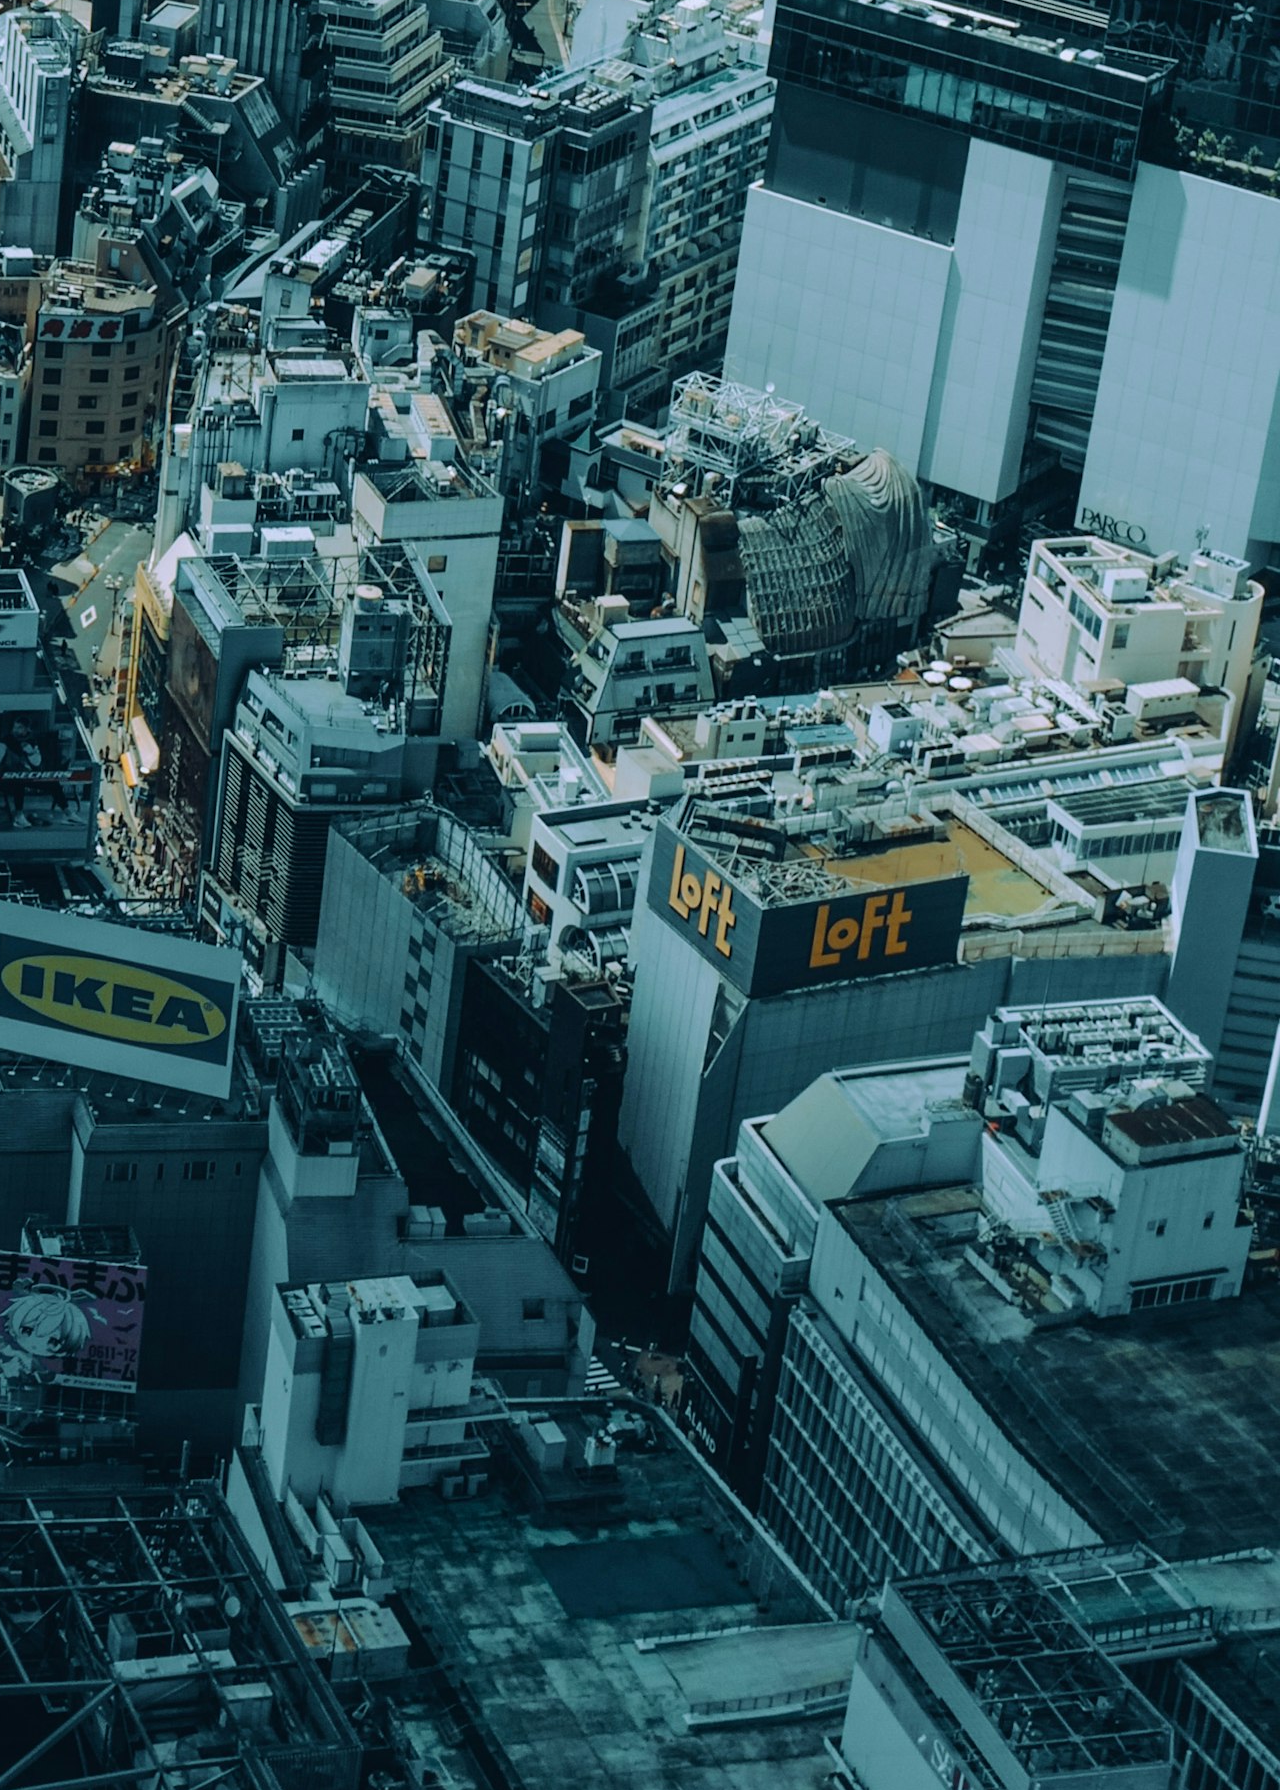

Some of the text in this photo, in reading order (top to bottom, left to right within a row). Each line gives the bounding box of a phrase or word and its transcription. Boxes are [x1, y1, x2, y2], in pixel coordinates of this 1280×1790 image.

[1081, 507, 1146, 545] PARCO
[2, 769, 75, 780] SKECHERS
[19, 963, 211, 1036] IKEA
[88, 1345, 137, 1365] 0611-12
[61, 1356, 137, 1381] 東京ドーム
